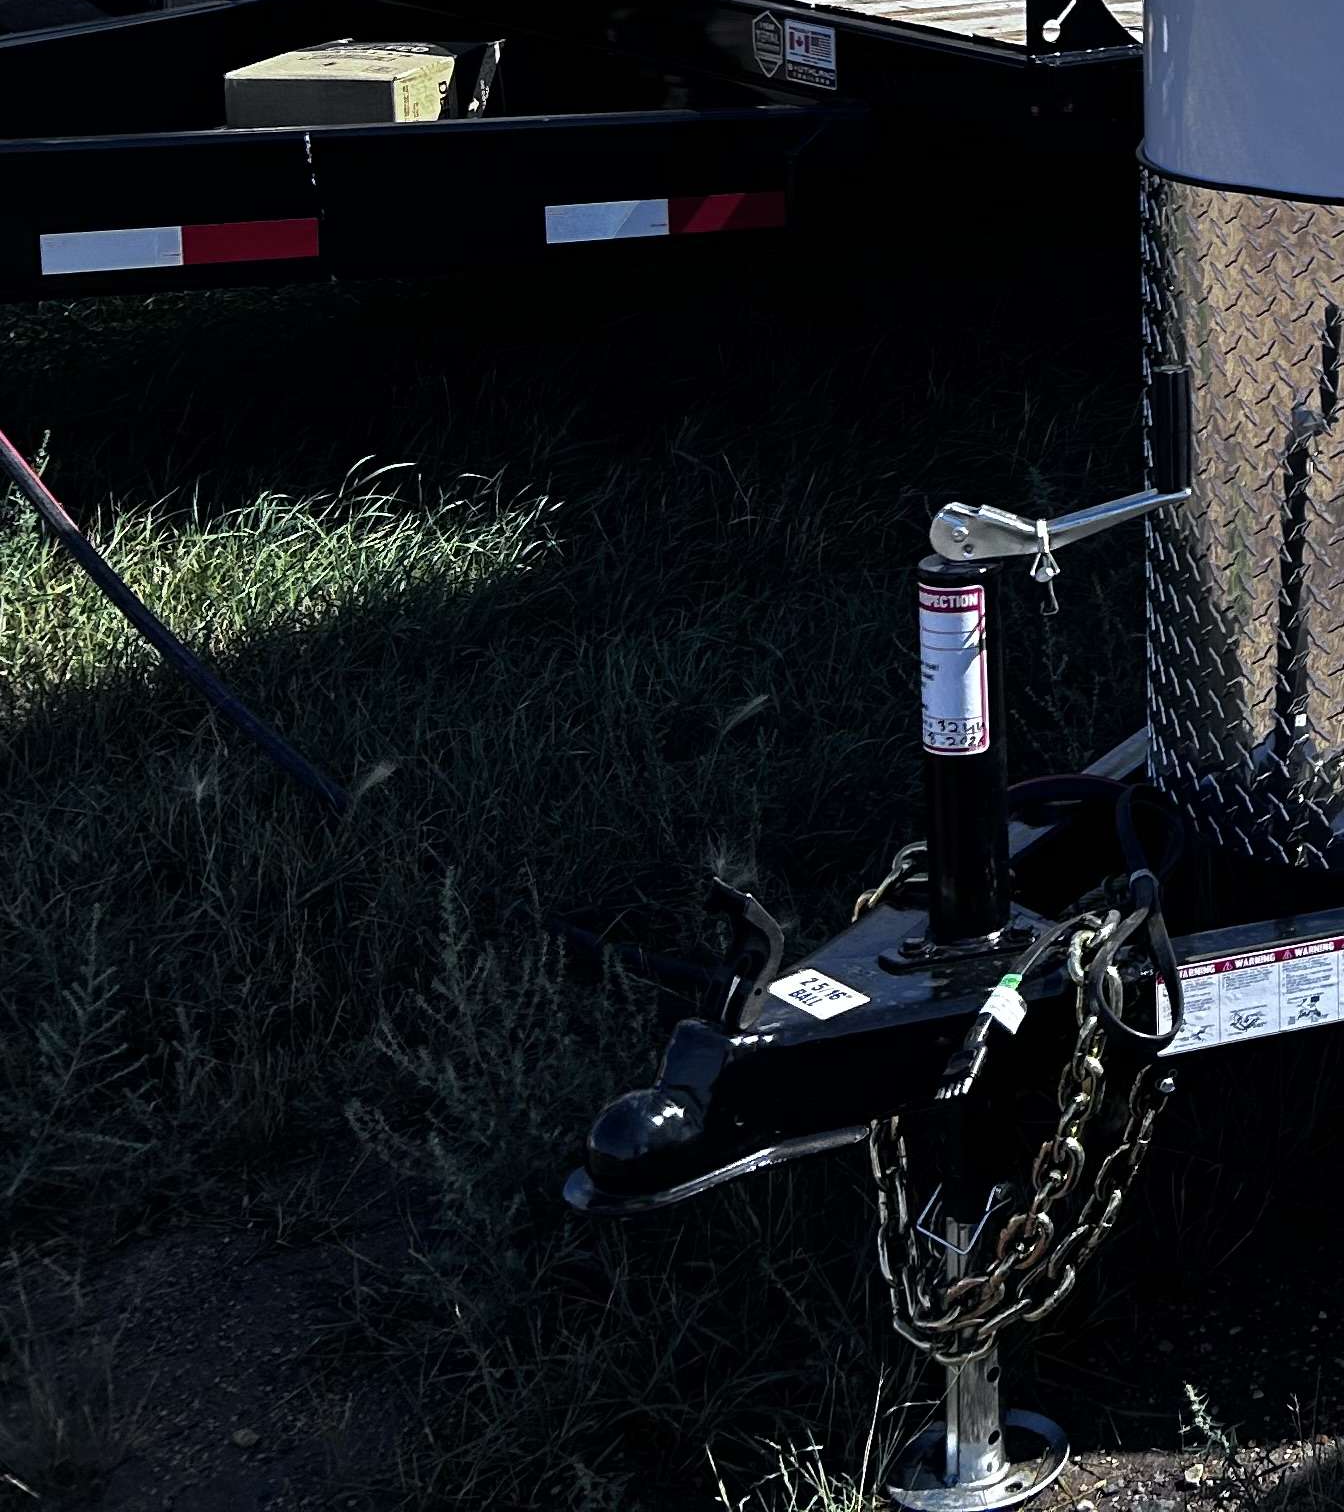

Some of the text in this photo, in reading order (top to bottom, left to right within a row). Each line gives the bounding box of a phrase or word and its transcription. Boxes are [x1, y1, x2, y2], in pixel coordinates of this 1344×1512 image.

[1295, 942, 1334, 957] WARNING
[1235, 953, 1275, 968] WARNING
[800, 977, 819, 986] 2
[788, 989, 823, 1006] BALL
